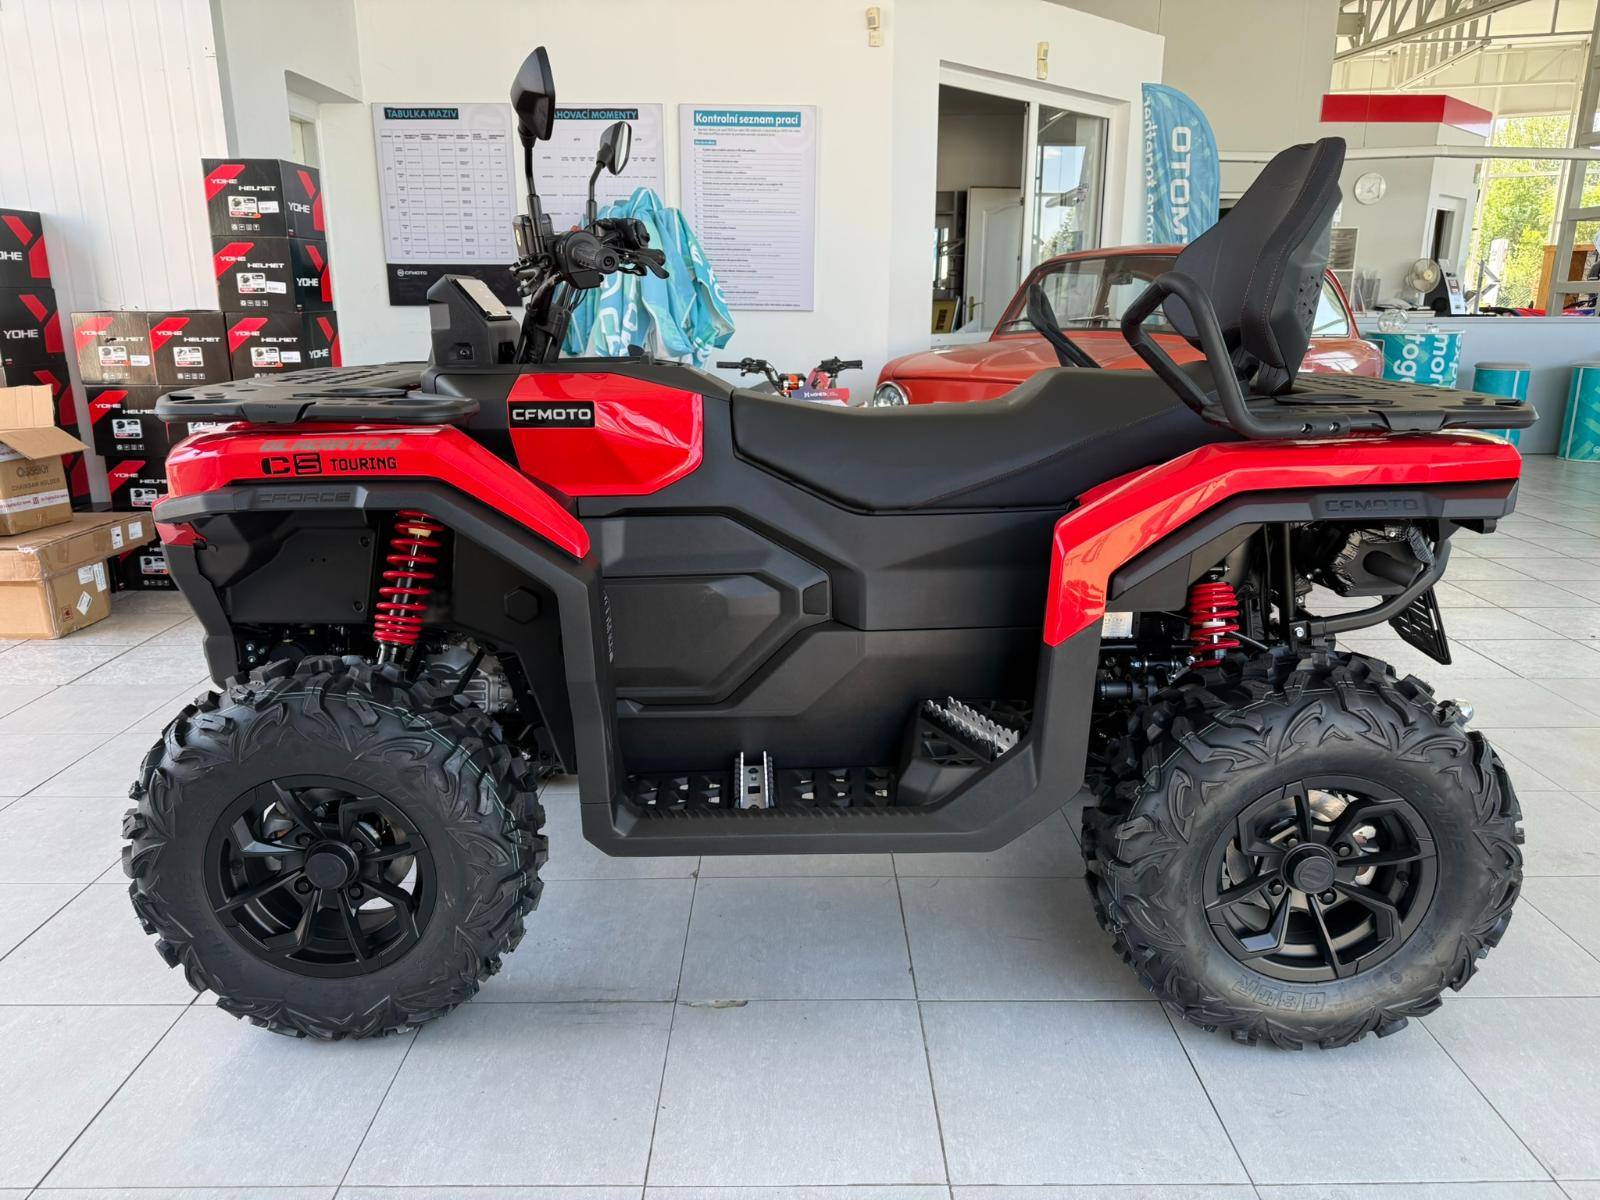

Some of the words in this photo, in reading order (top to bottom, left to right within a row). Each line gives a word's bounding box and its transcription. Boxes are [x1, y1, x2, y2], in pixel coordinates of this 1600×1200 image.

[386, 109, 427, 119] TABULKA
[427, 109, 458, 119] MAZIV
[554, 109, 590, 119] HOVACÍ
[591, 111, 637, 119] MOMENTY
[695, 112, 738, 124] Kontrolní
[739, 116, 774, 124] seznam
[775, 115, 799, 127] prací
[288, 201, 311, 214] YOHE
[0, 251, 23, 261] HE
[296, 277, 319, 287] YOHE
[3, 328, 39, 340] YOHE
[308, 348, 329, 359] YOHE
[511, 408, 592, 421] CFMOTO
[329, 456, 398, 472] TOURING
[1324, 499, 1419, 513] CFMOTO
